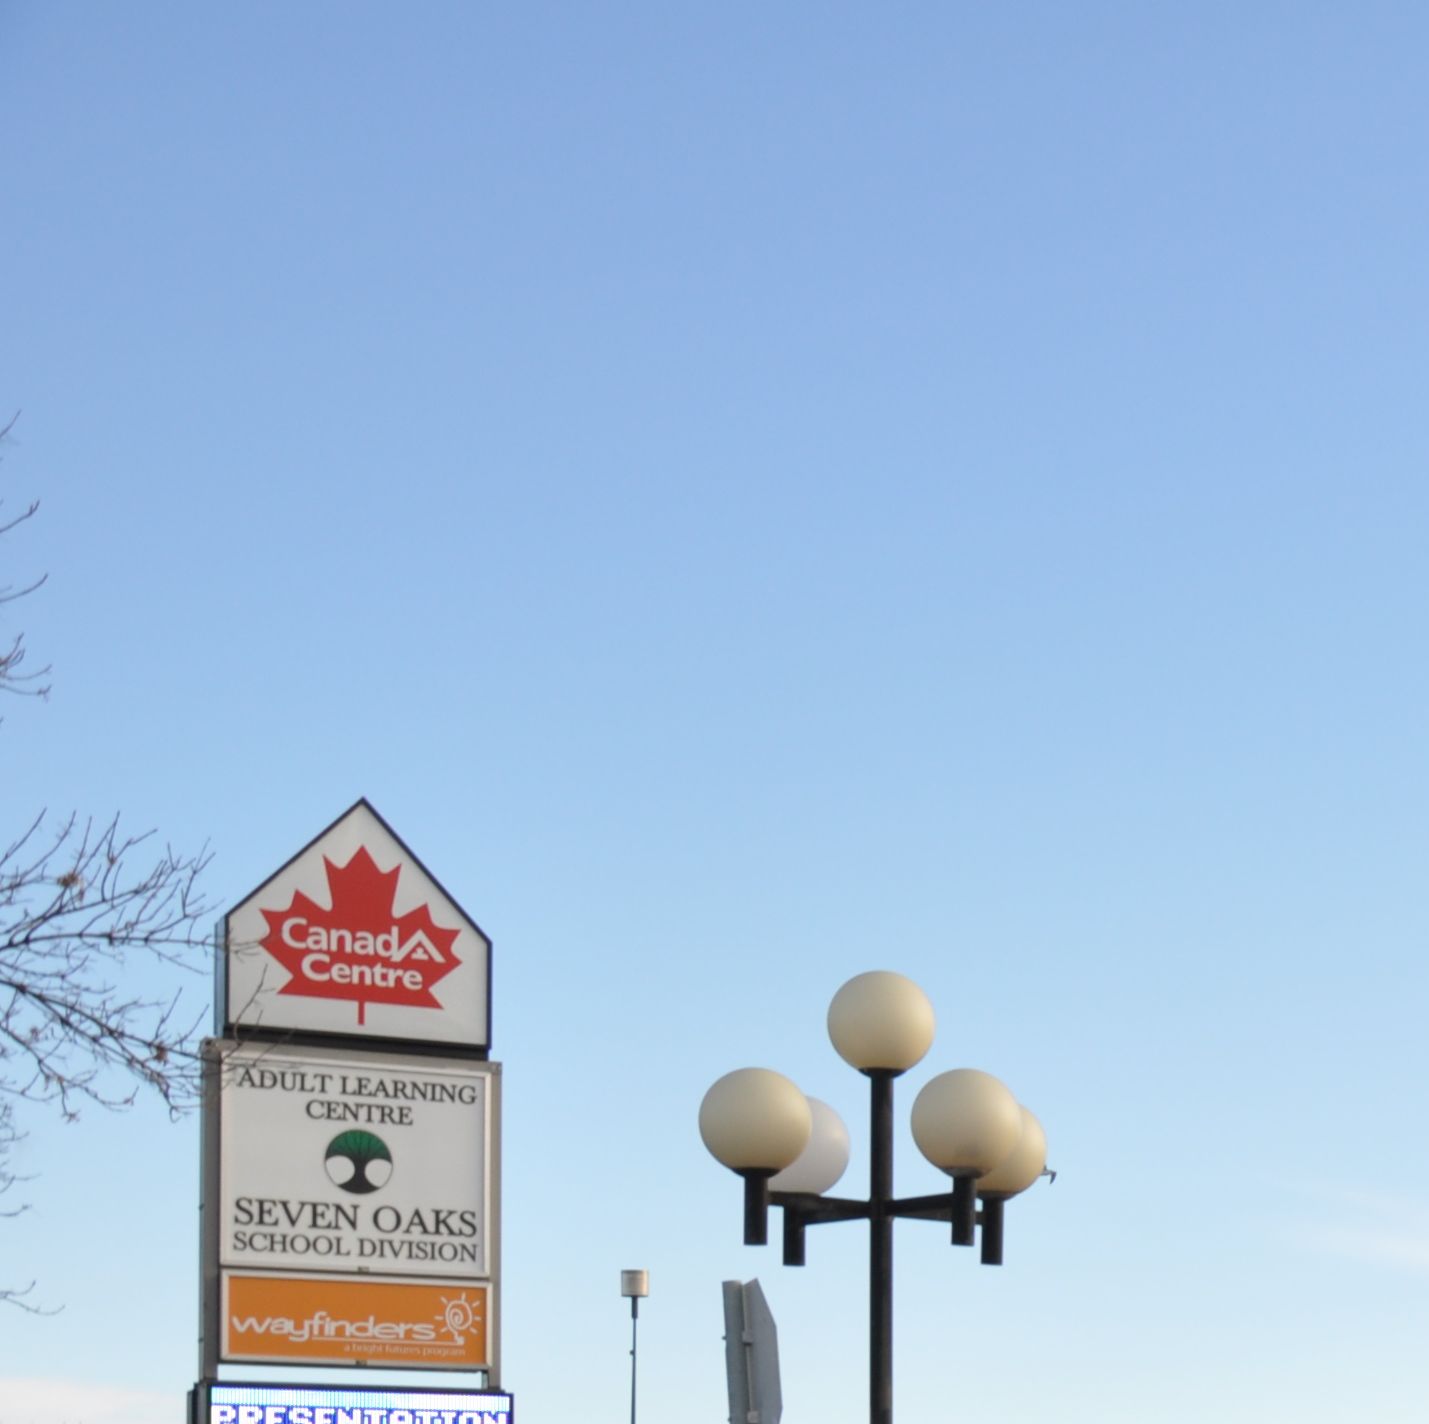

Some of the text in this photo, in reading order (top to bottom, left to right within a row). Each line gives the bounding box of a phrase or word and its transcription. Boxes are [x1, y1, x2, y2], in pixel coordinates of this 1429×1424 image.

[301, 952, 423, 991] Centre
[236, 1067, 477, 1104] ADULT LEARNING
[305, 1100, 414, 1126] CENTRE
[234, 1197, 477, 1238] SEVEN OAKS
[233, 1231, 478, 1262] SCHOOL DIVISION
[231, 1311, 436, 1342] wayfinders
